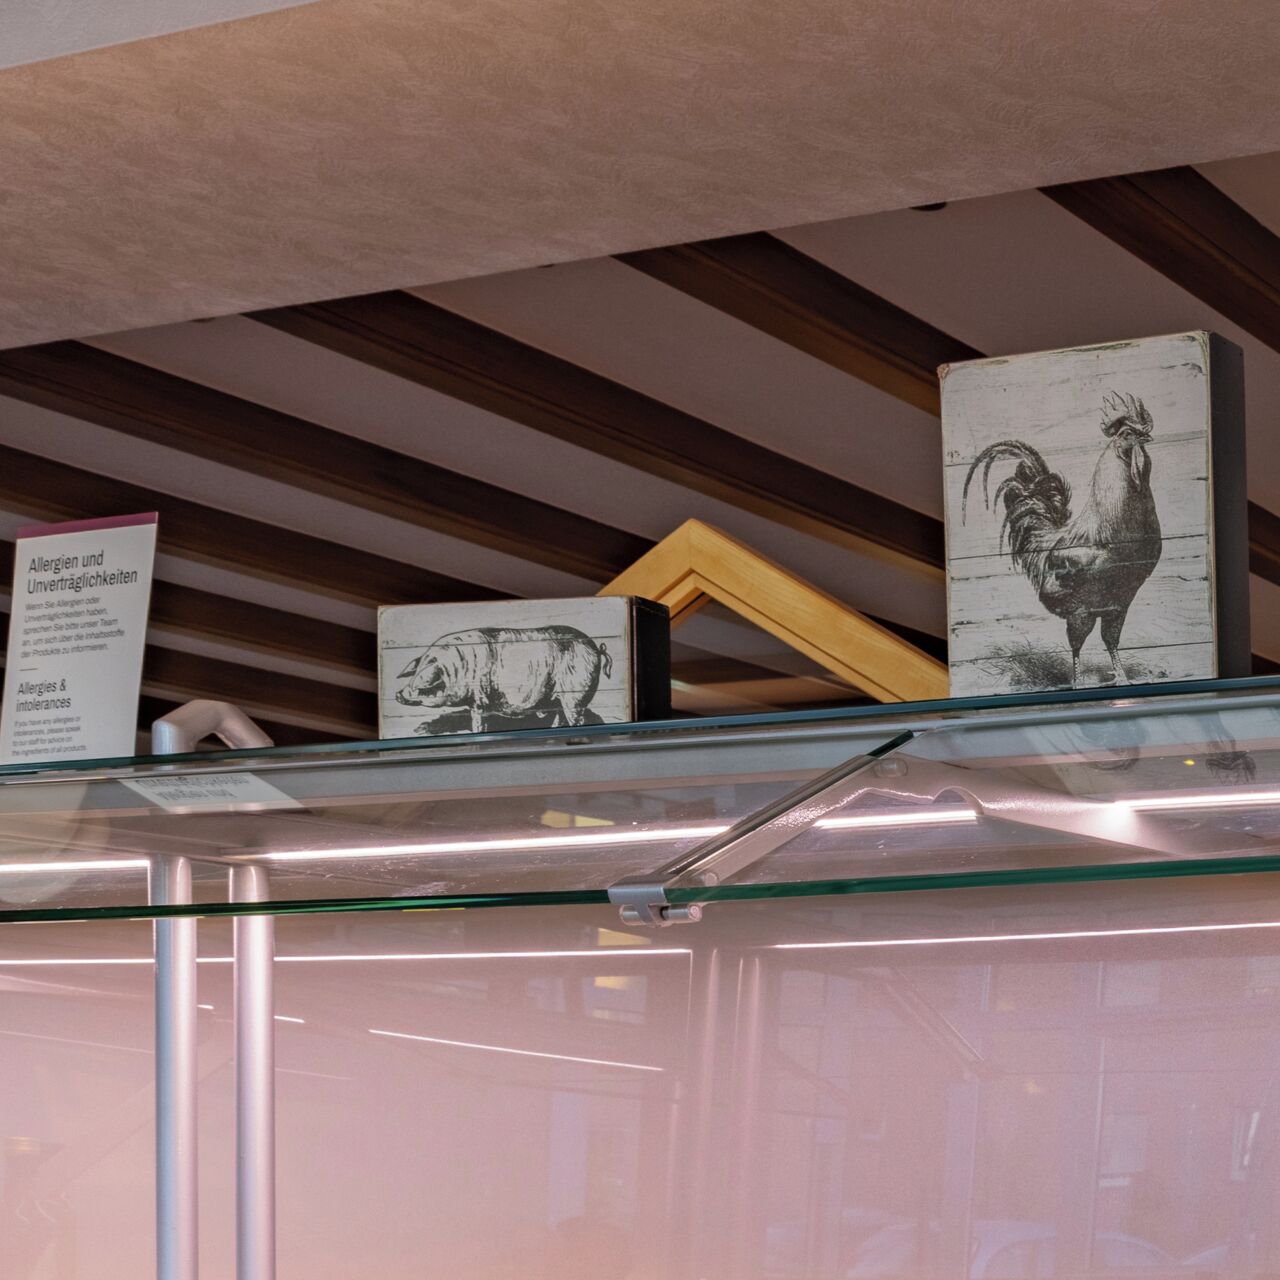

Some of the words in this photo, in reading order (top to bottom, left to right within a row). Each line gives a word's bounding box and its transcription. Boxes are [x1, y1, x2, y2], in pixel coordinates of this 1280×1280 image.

[28, 553, 78, 574] Allergien
[81, 549, 104, 568] und
[27, 568, 138, 594] Unverträglichkeiten
[17, 680, 57, 697] Allergies
[60, 678, 66, 691] &
[16, 697, 71, 712] intolerances
